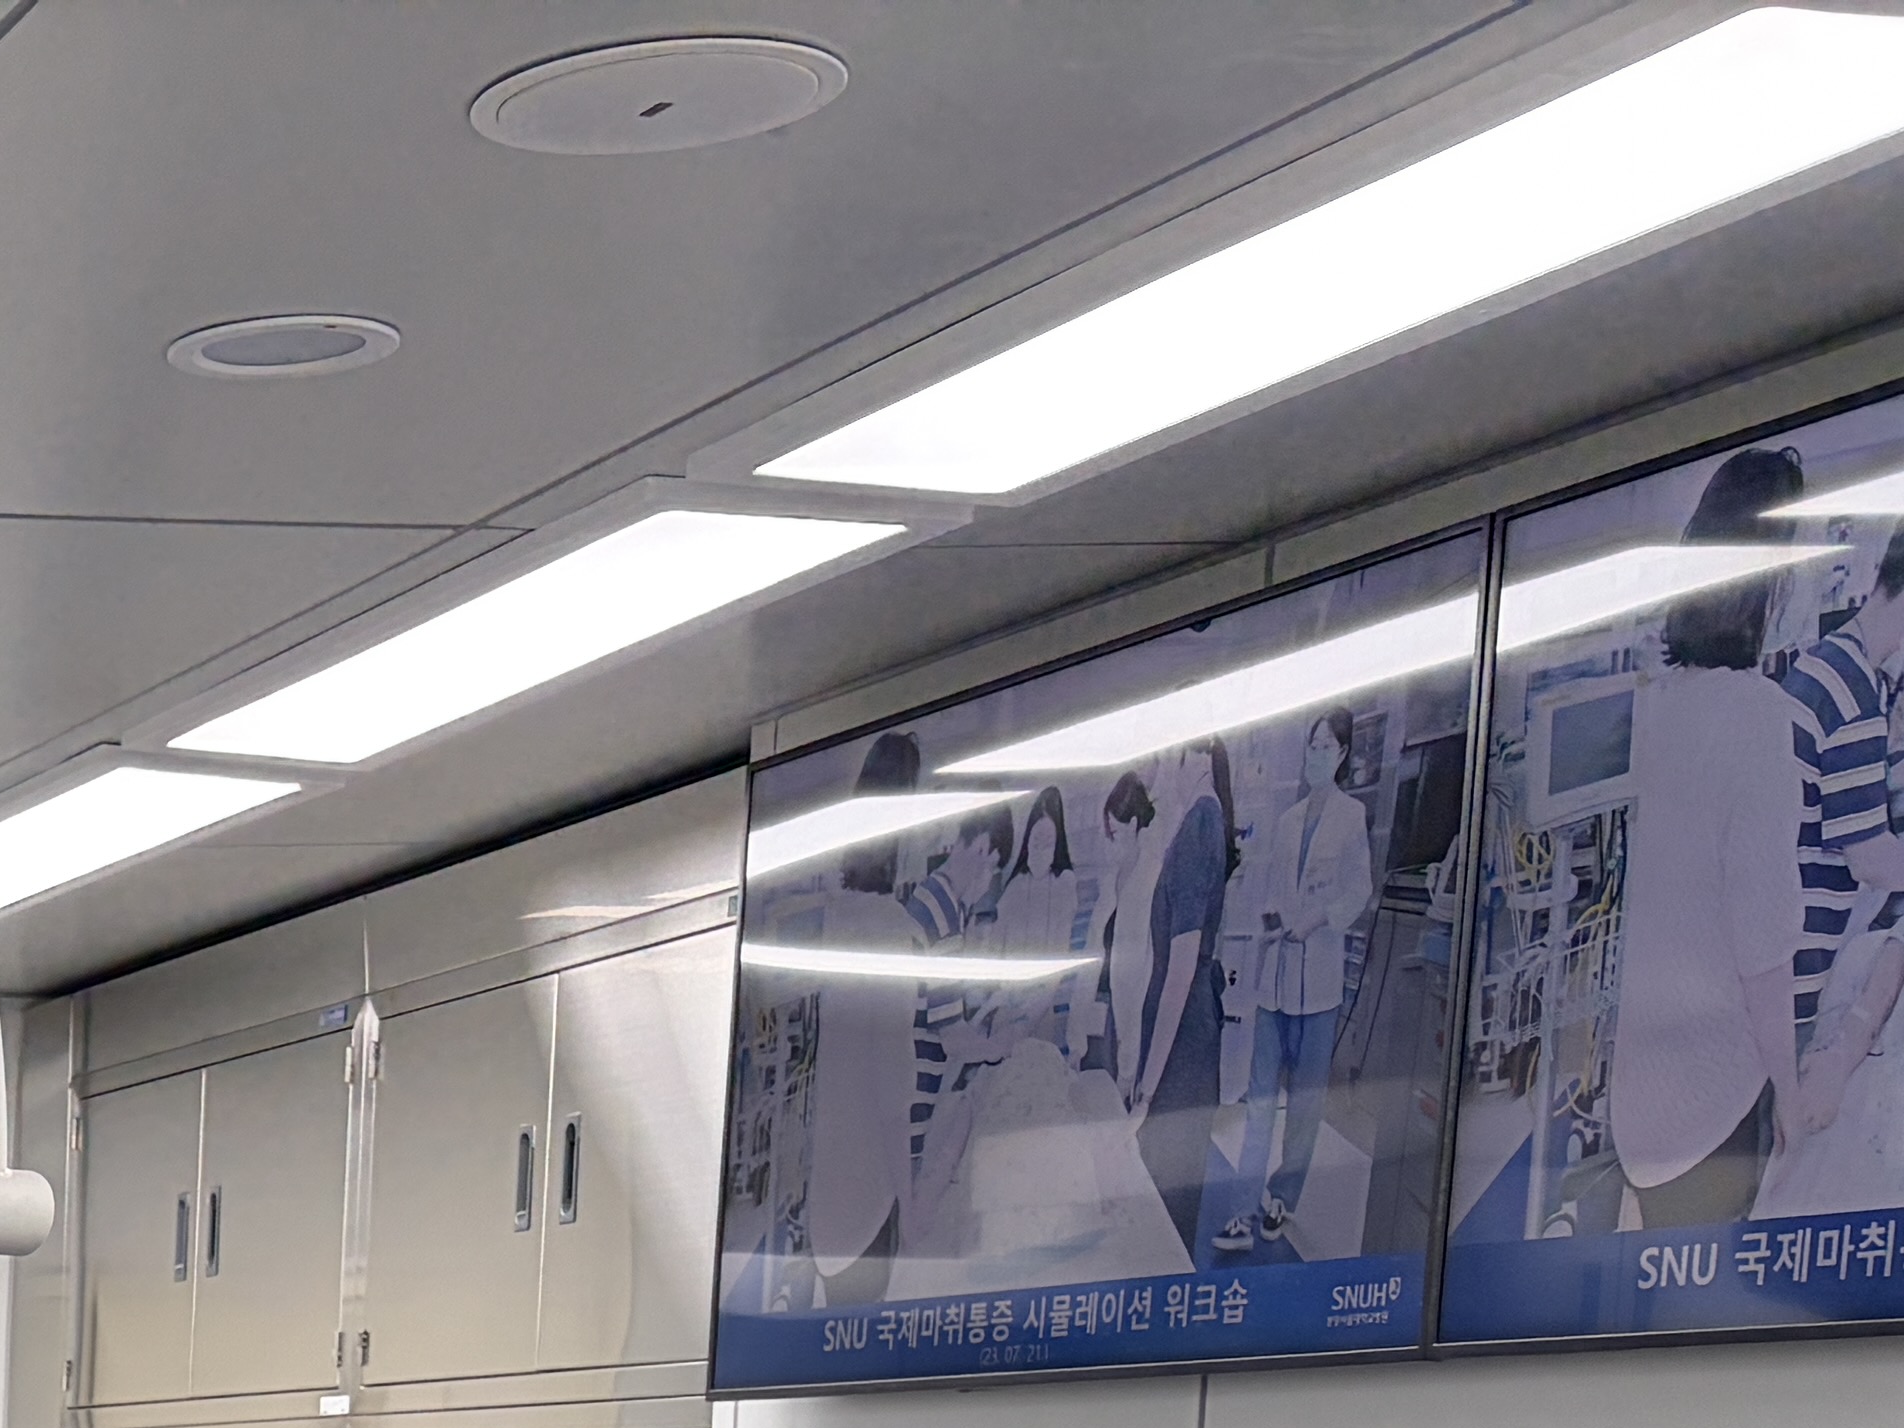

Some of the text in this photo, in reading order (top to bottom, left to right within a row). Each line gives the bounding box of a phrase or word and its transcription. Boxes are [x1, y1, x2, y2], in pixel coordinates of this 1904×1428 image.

[1637, 1219, 1904, 1290] SNU 국제마취
[822, 1277, 1250, 1352] SNU 국제마취통증 시뮬레이션 워크숍
[1330, 1282, 1388, 1311] SNUH
